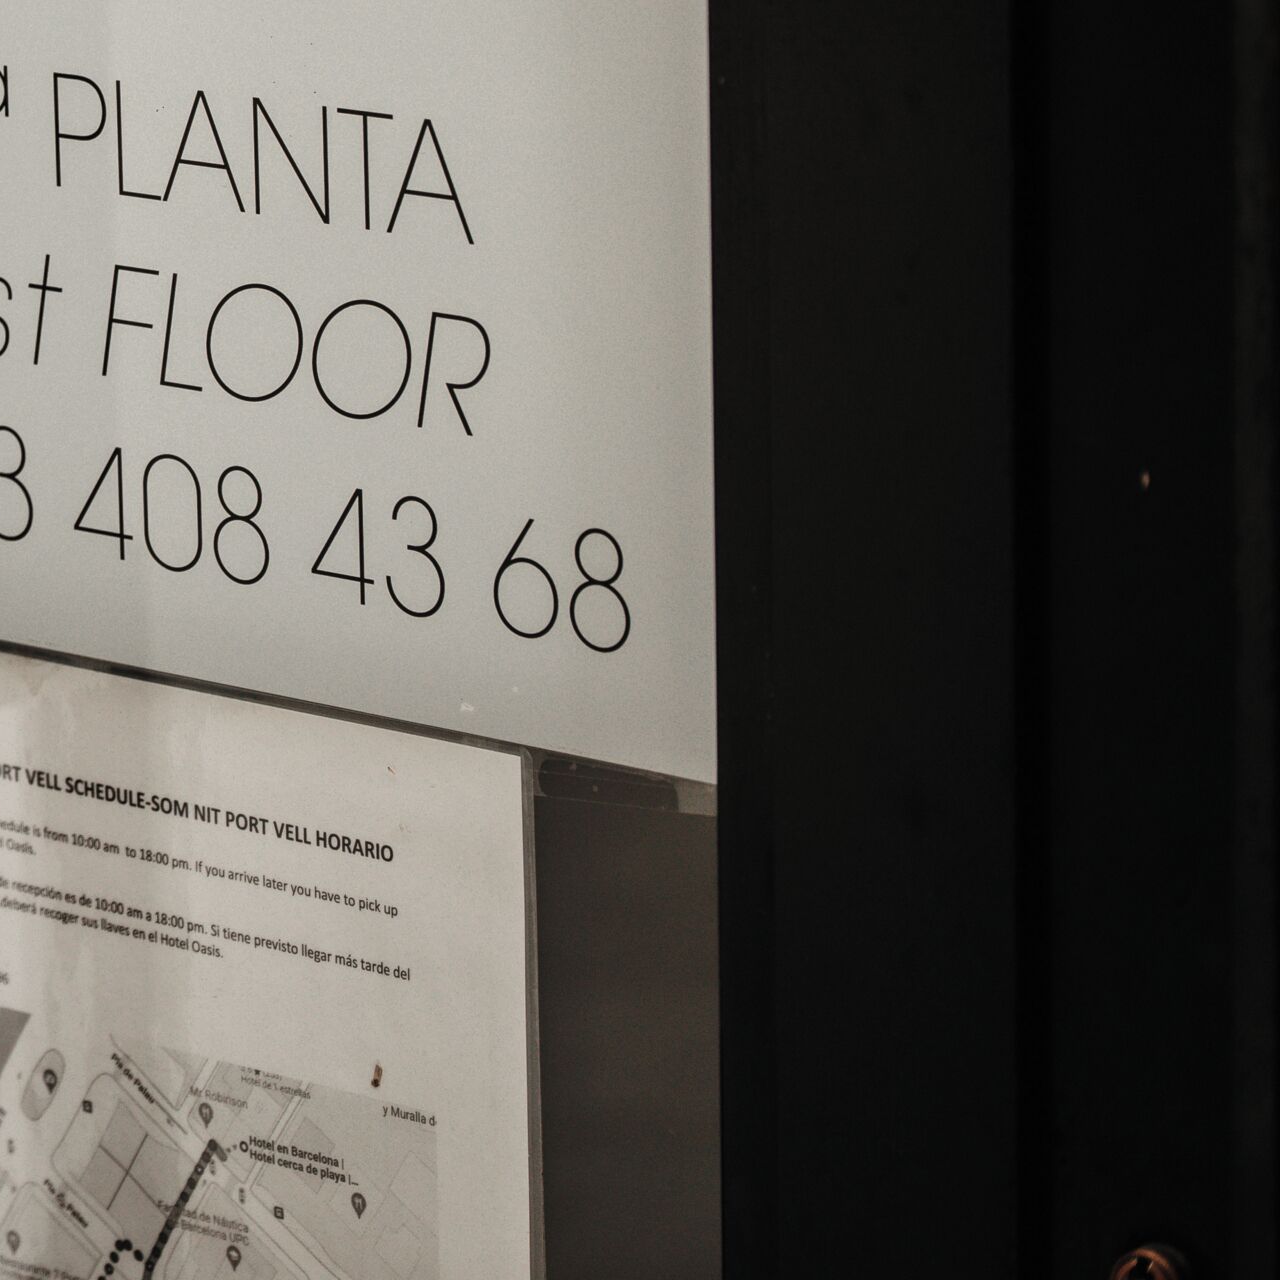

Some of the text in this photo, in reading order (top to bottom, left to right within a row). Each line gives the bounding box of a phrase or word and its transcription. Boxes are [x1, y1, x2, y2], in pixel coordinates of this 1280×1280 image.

[53, 71, 475, 246] PLANTA
[102, 264, 491, 437] FLOOR
[72, 447, 271, 586] 408
[310, 488, 446, 618] 43
[492, 518, 632, 654] 68
[25, 768, 62, 792] VELL
[65, 777, 189, 818] SCHEDULE-SOM
[194, 804, 221, 825] NIT
[226, 811, 269, 835] PORT
[273, 821, 312, 845] VELL
[316, 830, 394, 862] HORARIO
[32, 826, 42, 838] is
[43, 827, 69, 843] from
[71, 833, 101, 850] 10:00
[103, 842, 120, 854] am
[125, 845, 137, 858] to
[139, 848, 169, 865] 18:00
[172, 857, 192, 871] pm.
[195, 861, 202, 873] If
[205, 863, 226, 880] you
[228, 869, 260, 886] arrive
[262, 874, 288, 892] later
[290, 883, 312, 900] you
[314, 886, 341, 904] have
[343, 894, 356, 907] to
[358, 897, 381, 913] pick
[383, 903, 399, 918] up
[12, 879, 63, 902] recepción
[64, 892, 77, 904] es
[79, 893, 92, 908] de
[94, 897, 124, 915] 10:00
[126, 907, 143, 920] am
[145, 911, 152, 922] a
[155, 911, 185, 929] 18:00
[187, 920, 208, 935] pm.
[210, 923, 220, 937] Si
[222, 927, 251, 945] tiene
[253, 933, 299, 956] previsto
[301, 943, 332, 964] llegar
[334, 953, 358, 969] más
[360, 957, 391, 976] tarde
[393, 965, 411, 981] del
[39, 906, 79, 924] recoger
[81, 916, 99, 929] sus
[100, 918, 131, 937] llaves
[132, 929, 146, 941] en
[148, 931, 158, 944] el
[160, 933, 189, 951] Hotel
[191, 941, 224, 959] Oasis.
[249, 1135, 339, 1168] Hotel en Barcelona
[382, 1104, 427, 1123] y Muralla
[250, 1149, 346, 1184] Hotel cerca de playa
